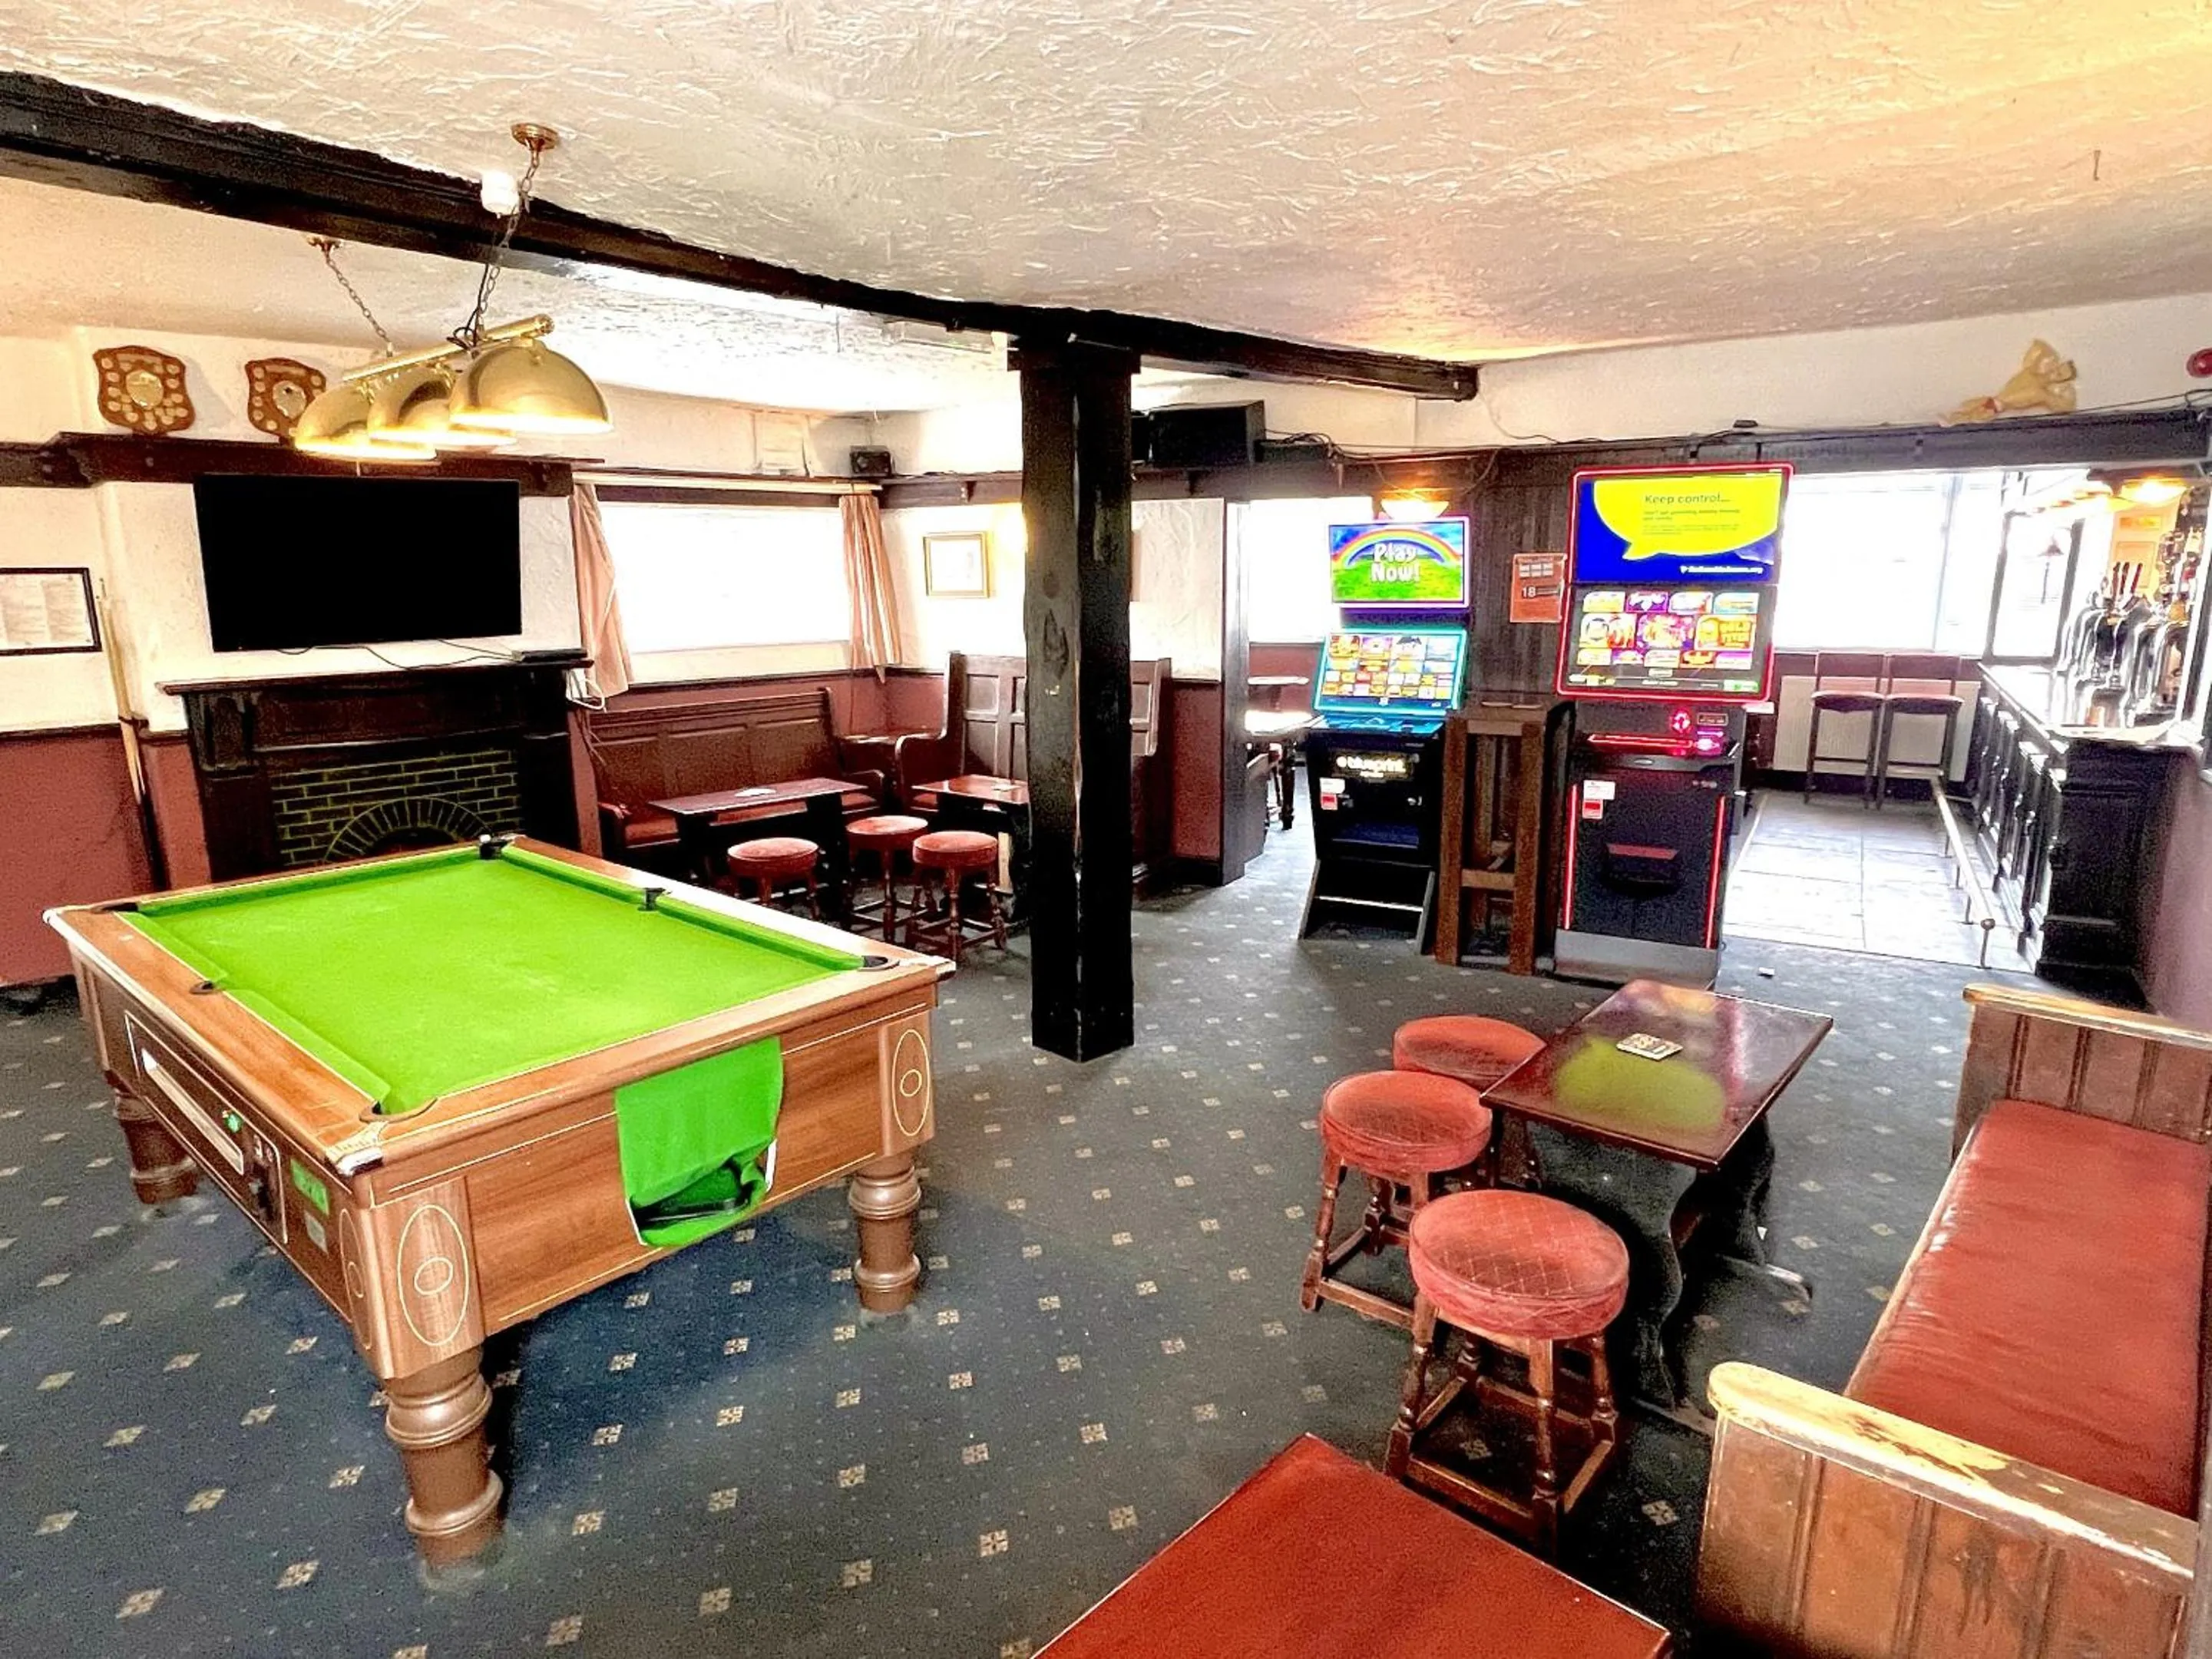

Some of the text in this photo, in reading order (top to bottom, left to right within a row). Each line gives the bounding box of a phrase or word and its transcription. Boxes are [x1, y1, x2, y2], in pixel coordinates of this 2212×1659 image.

[1645, 494, 1675, 504] Keep
[1374, 543, 1417, 563] Play
[1371, 563, 1420, 583] Now!
[1523, 587, 1536, 598] 18
